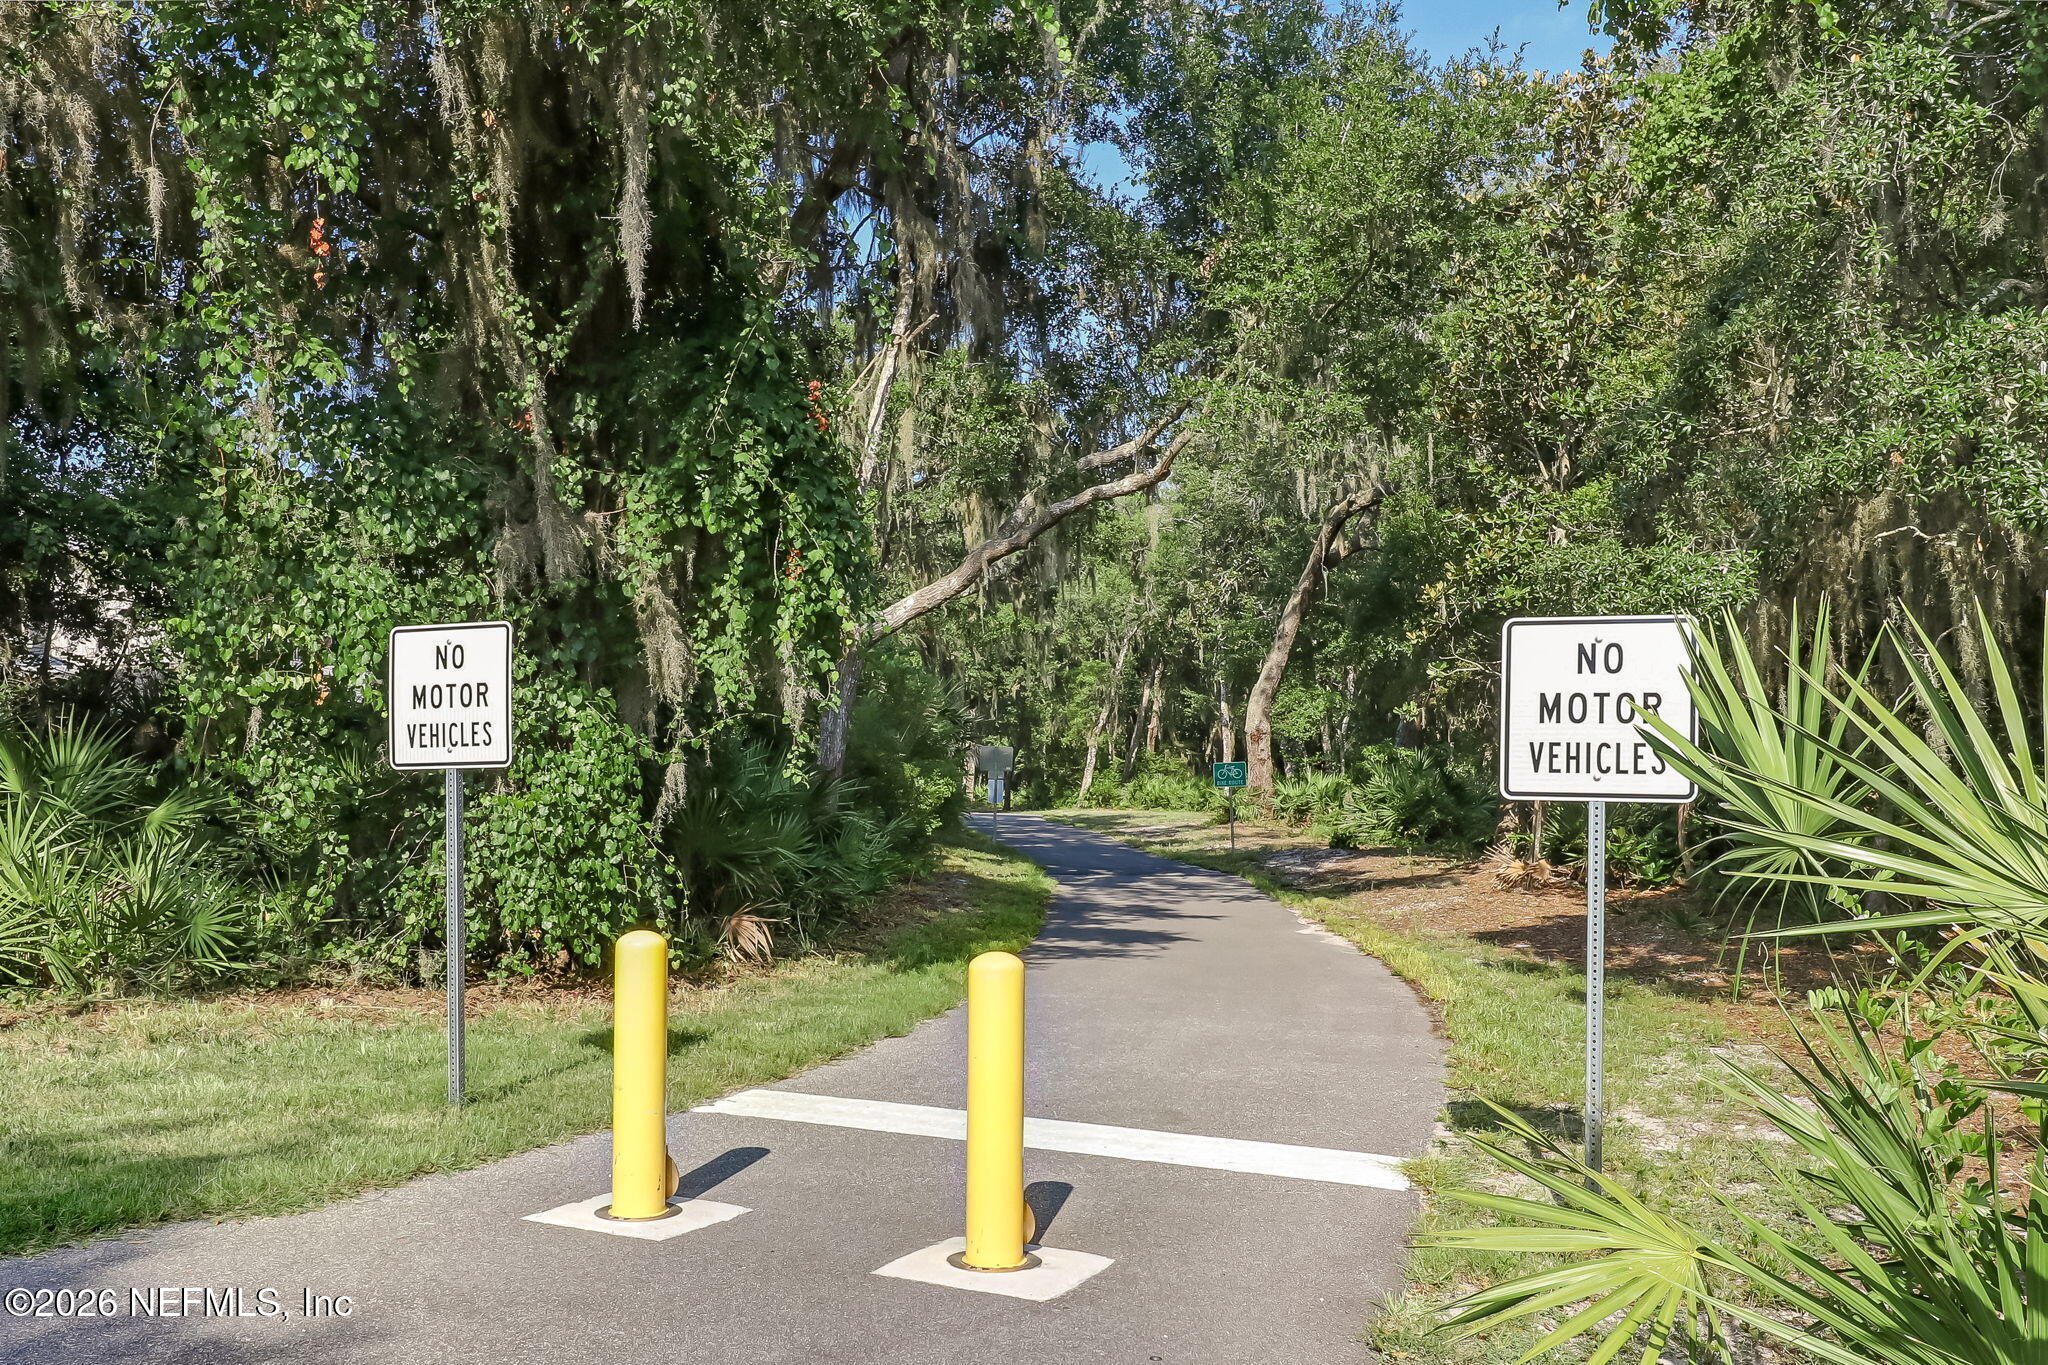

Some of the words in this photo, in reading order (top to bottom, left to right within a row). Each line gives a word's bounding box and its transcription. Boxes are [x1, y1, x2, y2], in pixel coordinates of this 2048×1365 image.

[436, 644, 464, 670] NO
[1577, 643, 1624, 674] NO
[413, 682, 488, 710] MOTOR
[1539, 692, 1662, 724] MOTOR
[407, 721, 492, 749] VEHICLES
